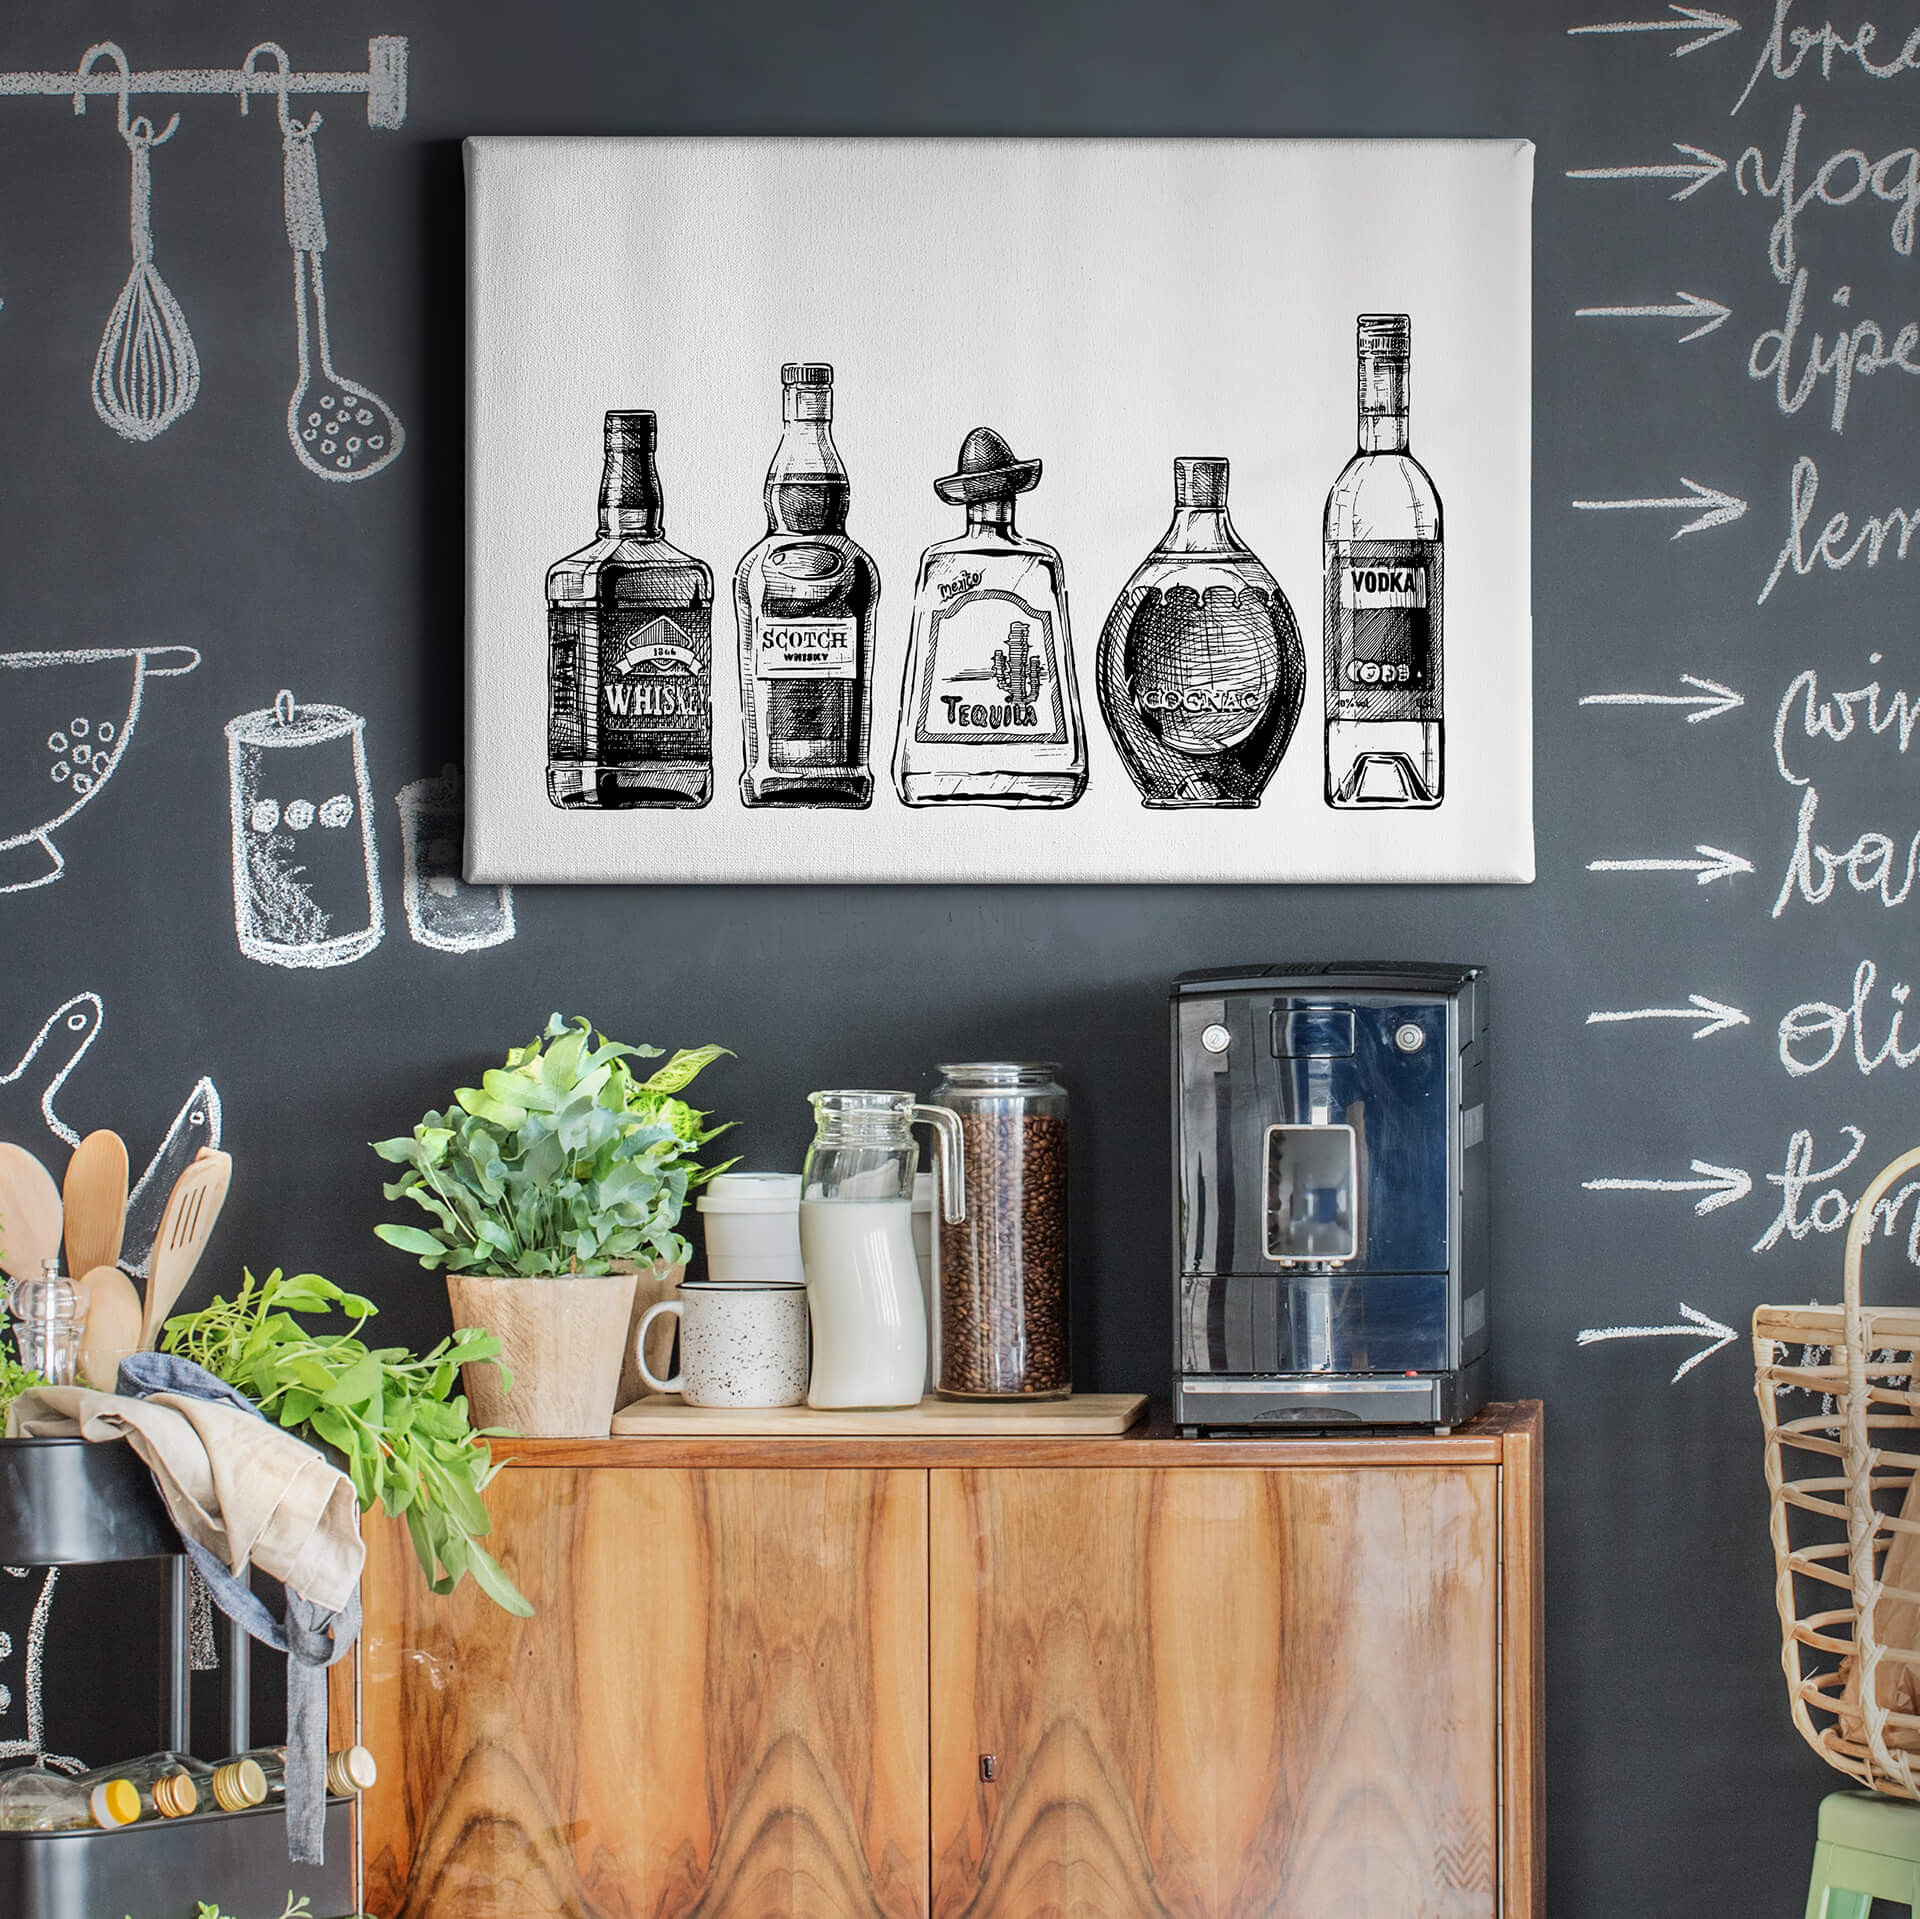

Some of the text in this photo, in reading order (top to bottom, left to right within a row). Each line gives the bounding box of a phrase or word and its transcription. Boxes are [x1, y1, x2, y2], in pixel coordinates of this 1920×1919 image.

[1729, 0, 1920, 116] bre
[1351, 571, 1416, 593] VODKA
[762, 628, 848, 652] SCOTCH
[783, 653, 829, 662] WHISKY
[604, 683, 708, 716] WHISKEY
[1142, 689, 1262, 713] COGNAC
